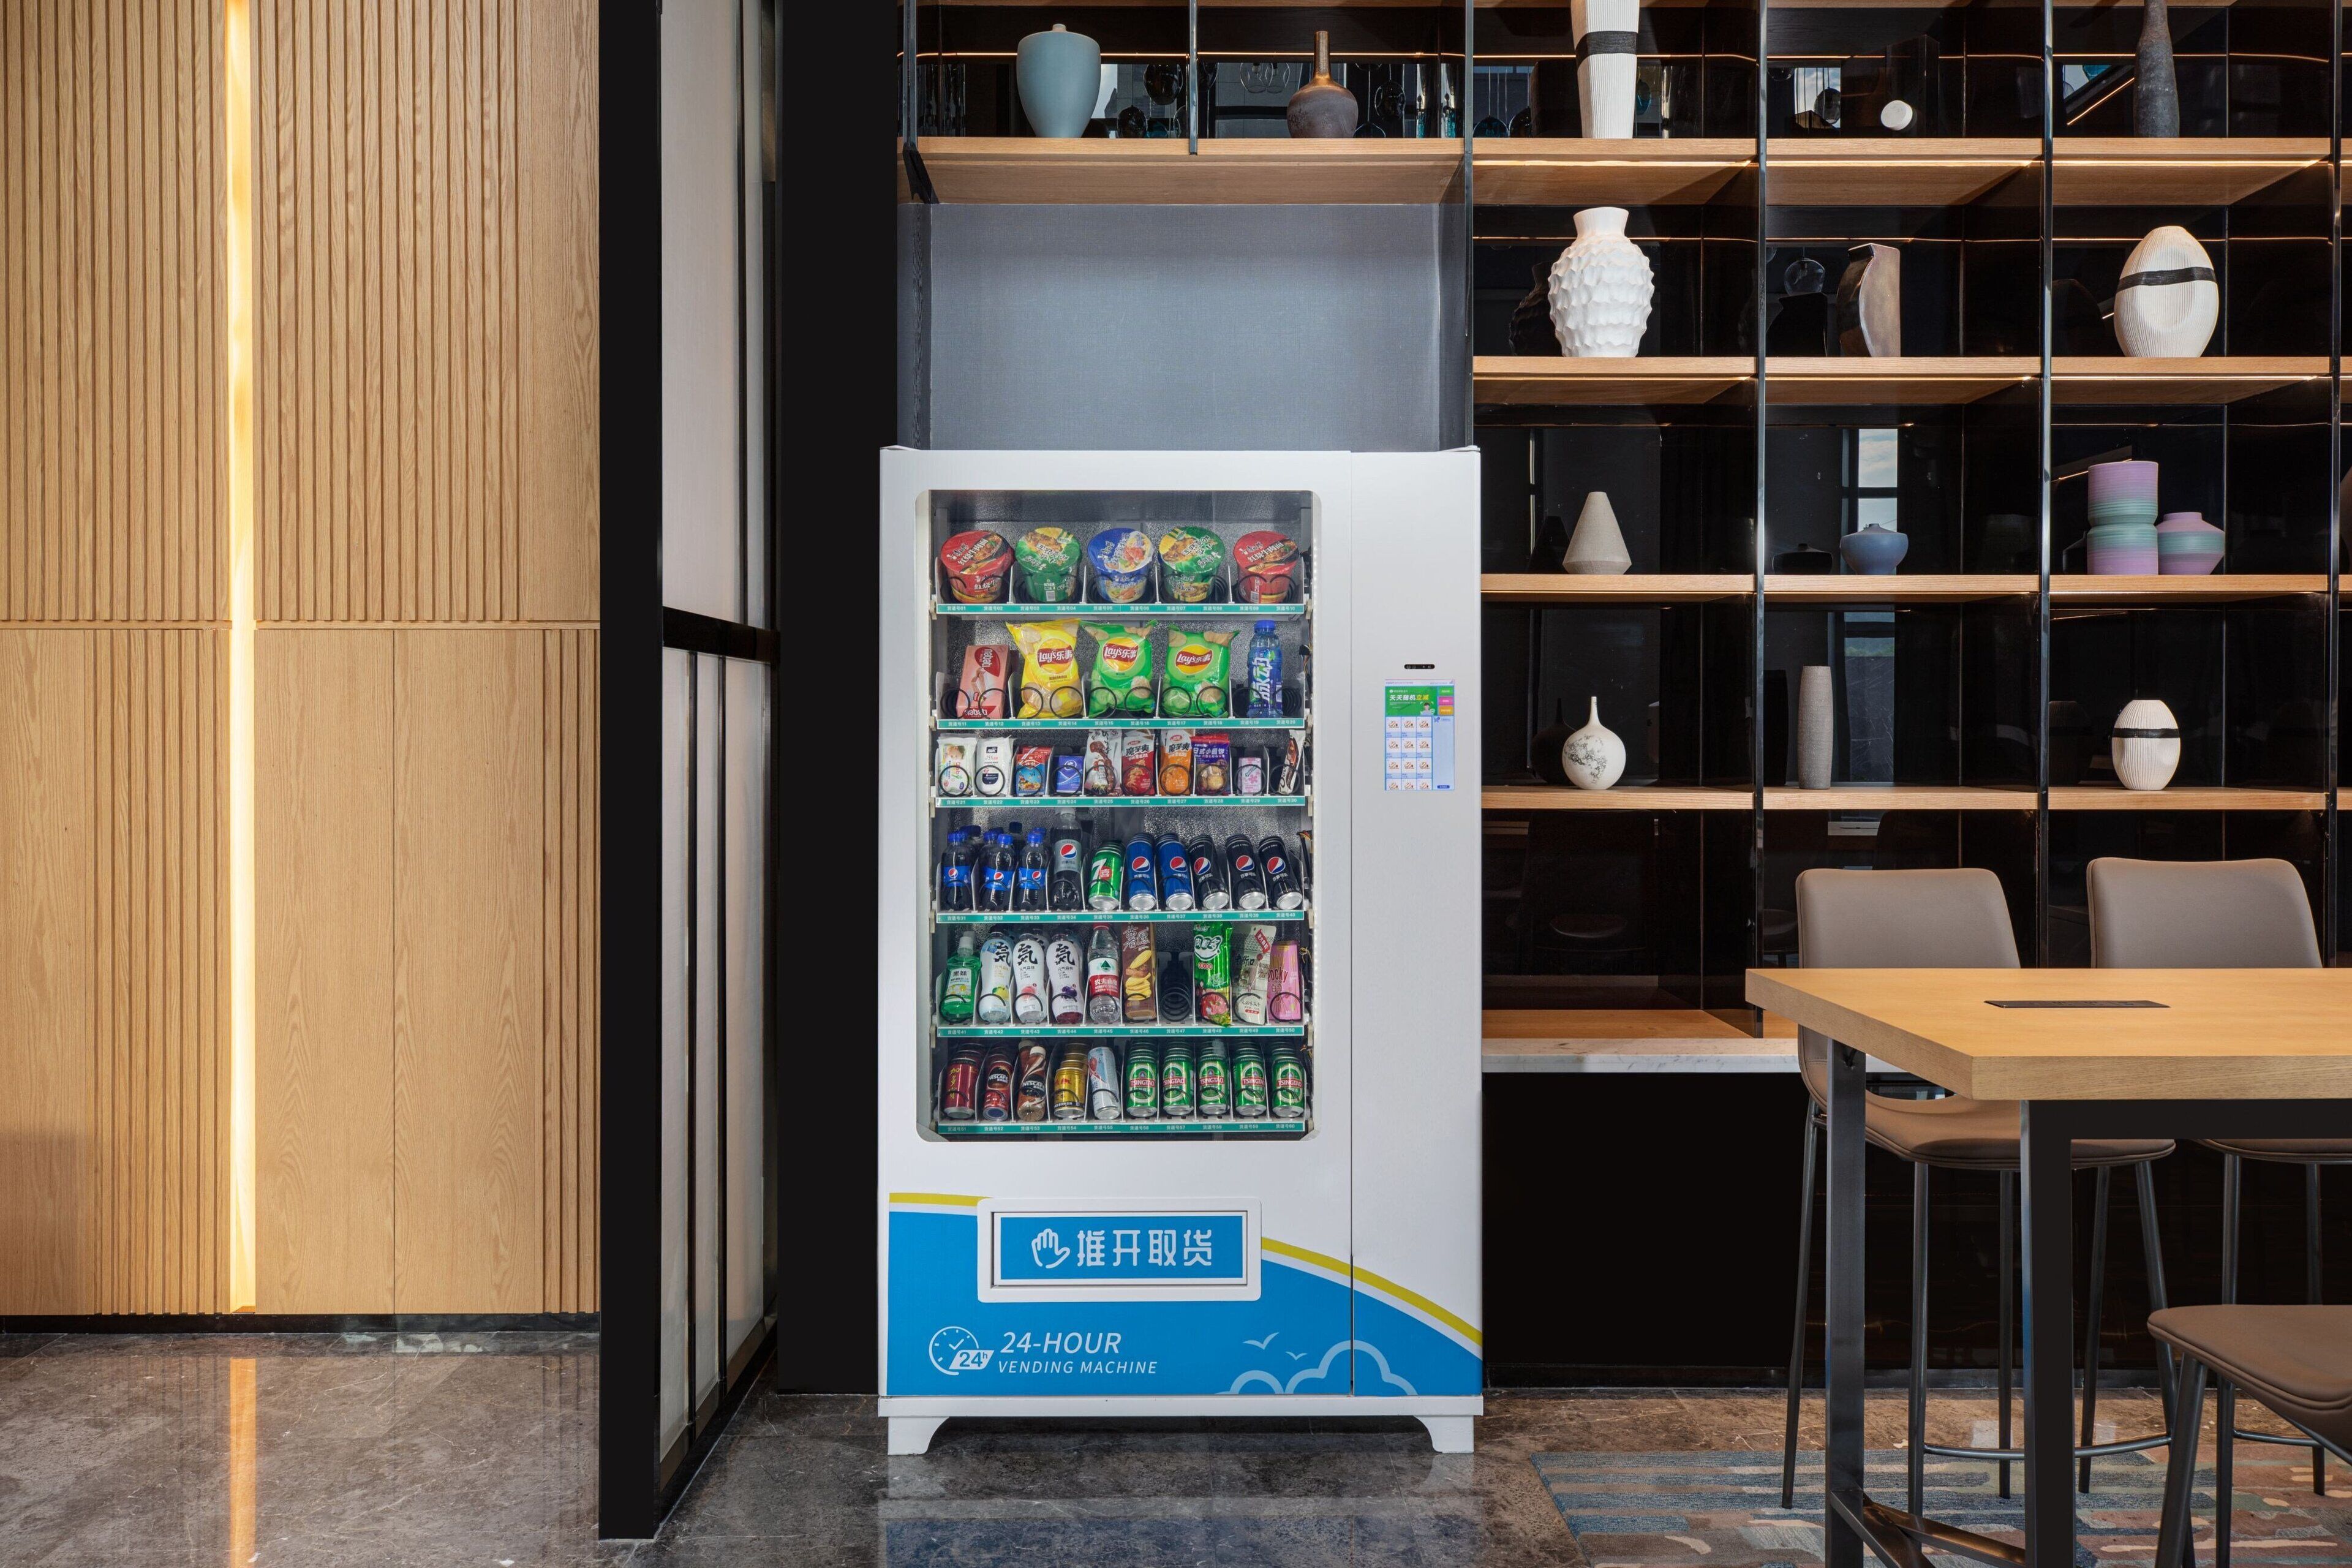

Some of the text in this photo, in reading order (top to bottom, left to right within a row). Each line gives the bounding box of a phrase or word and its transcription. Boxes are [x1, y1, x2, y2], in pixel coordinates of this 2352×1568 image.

[1077, 1229, 1212, 1267] 推开取货
[1000, 1332, 1121, 1354] 24-HOUR
[959, 1351, 988, 1368] 24h
[998, 1361, 1158, 1374] VENDING MACHINE
